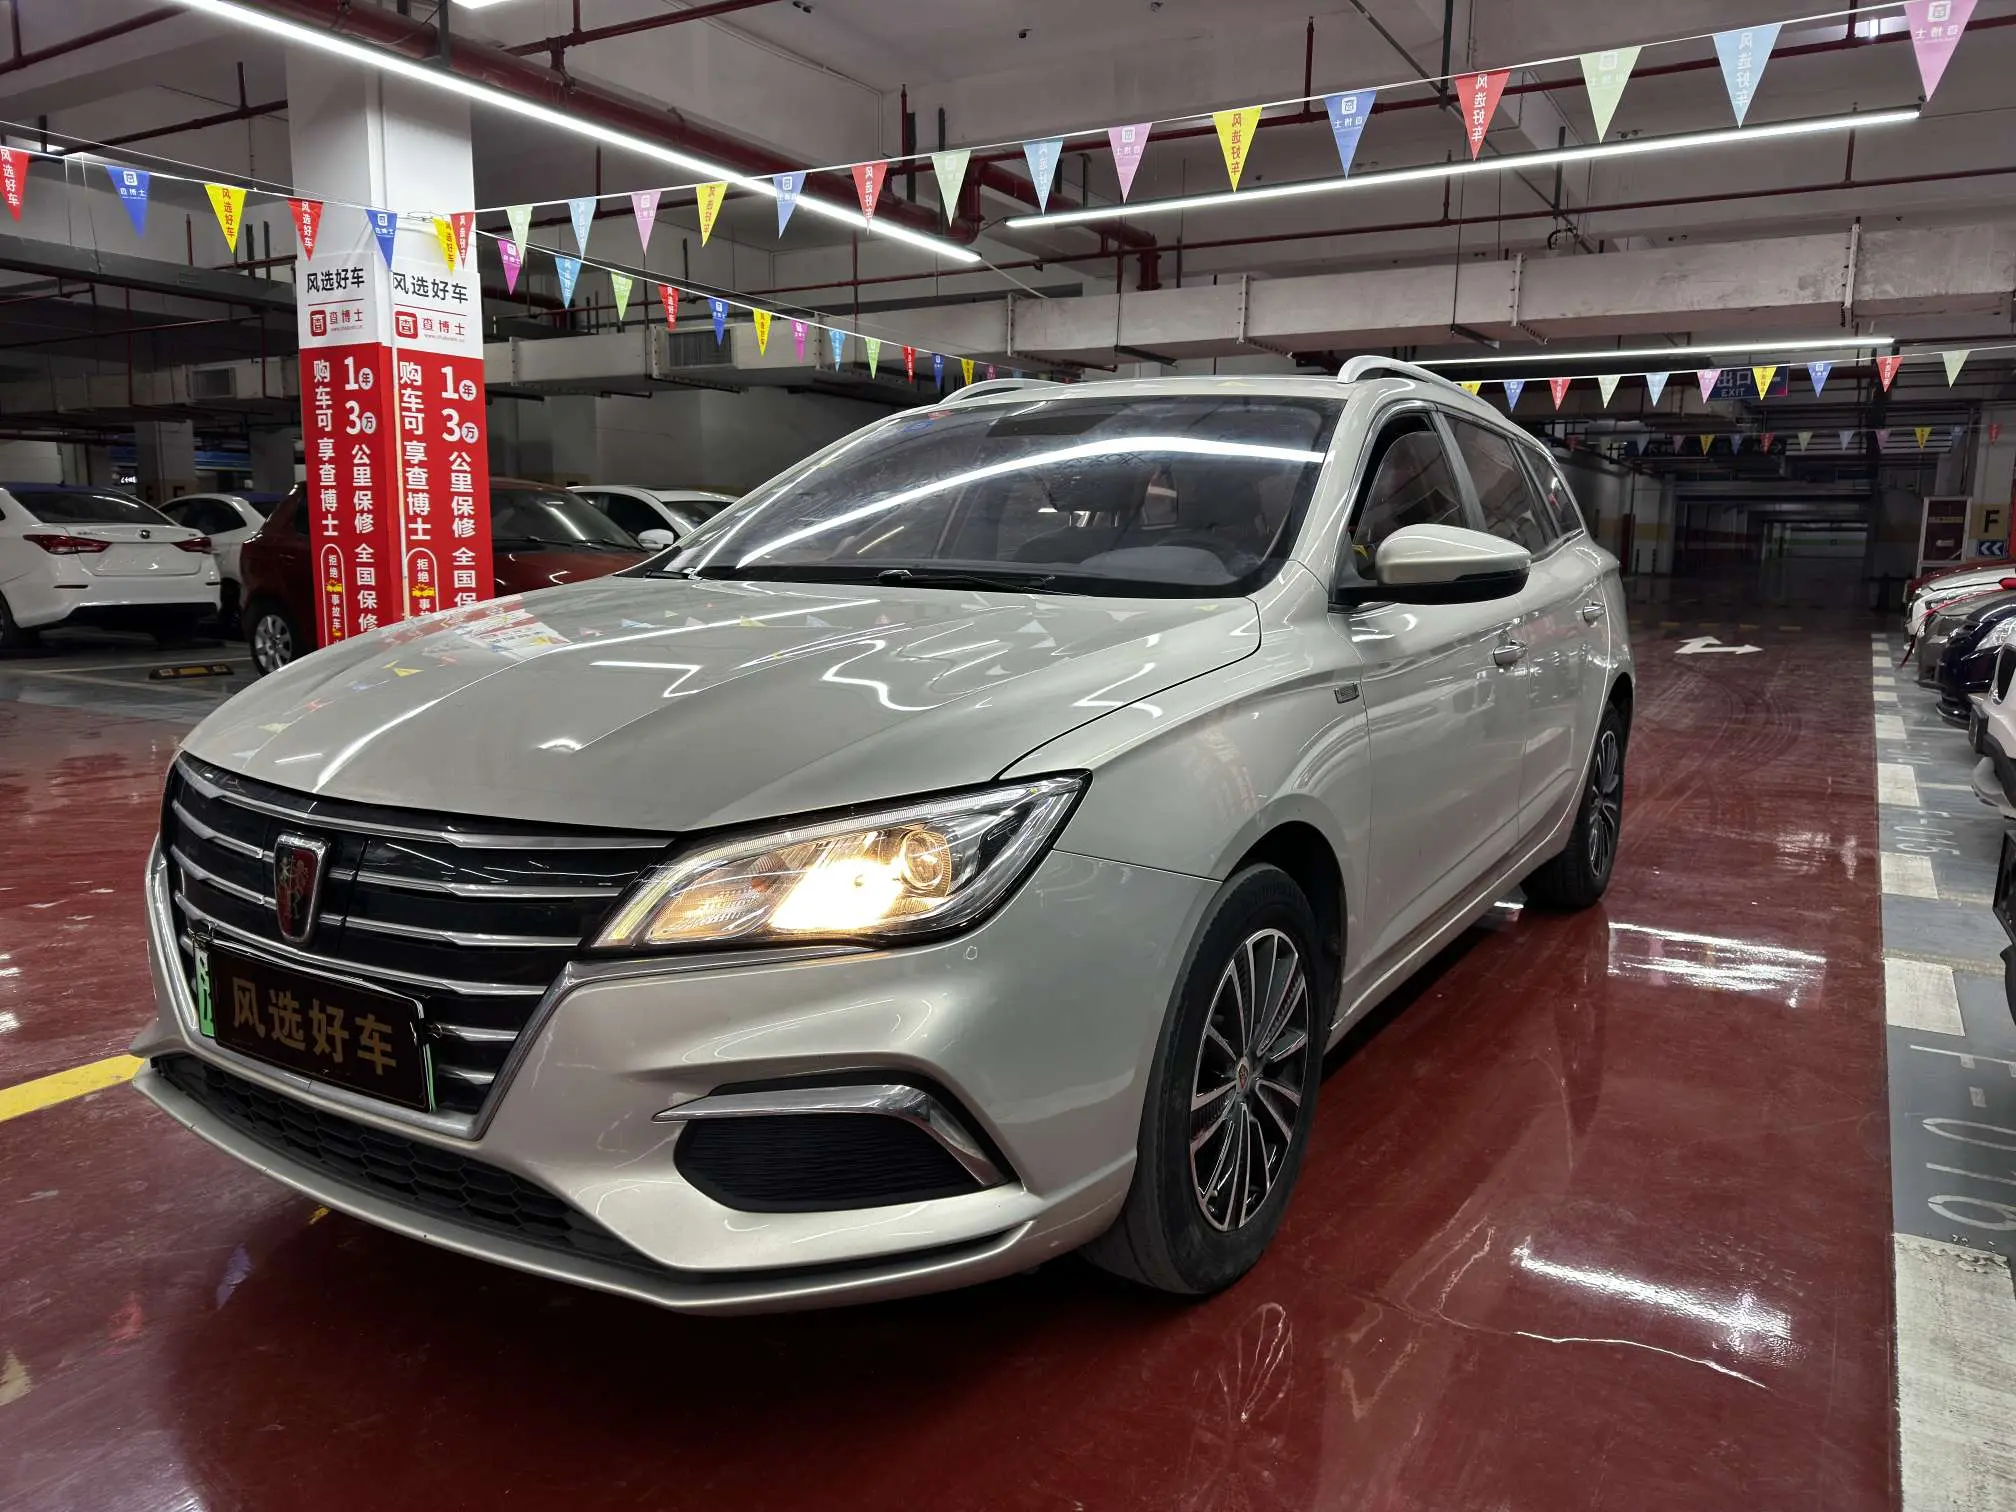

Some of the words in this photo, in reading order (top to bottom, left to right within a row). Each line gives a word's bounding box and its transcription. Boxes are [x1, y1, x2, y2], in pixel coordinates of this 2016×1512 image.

[0, 149, 20, 207] 风选好车
[222, 188, 235, 238] 风选好车
[302, 201, 313, 248] 风选好车
[307, 267, 365, 293] 风选好车
[393, 272, 468, 304] 风选好车
[1716, 370, 1752, 387] 出口
[1721, 387, 1745, 397] EXIT
[1984, 509, 2000, 533] F
[232, 976, 397, 1077] 风选好车
